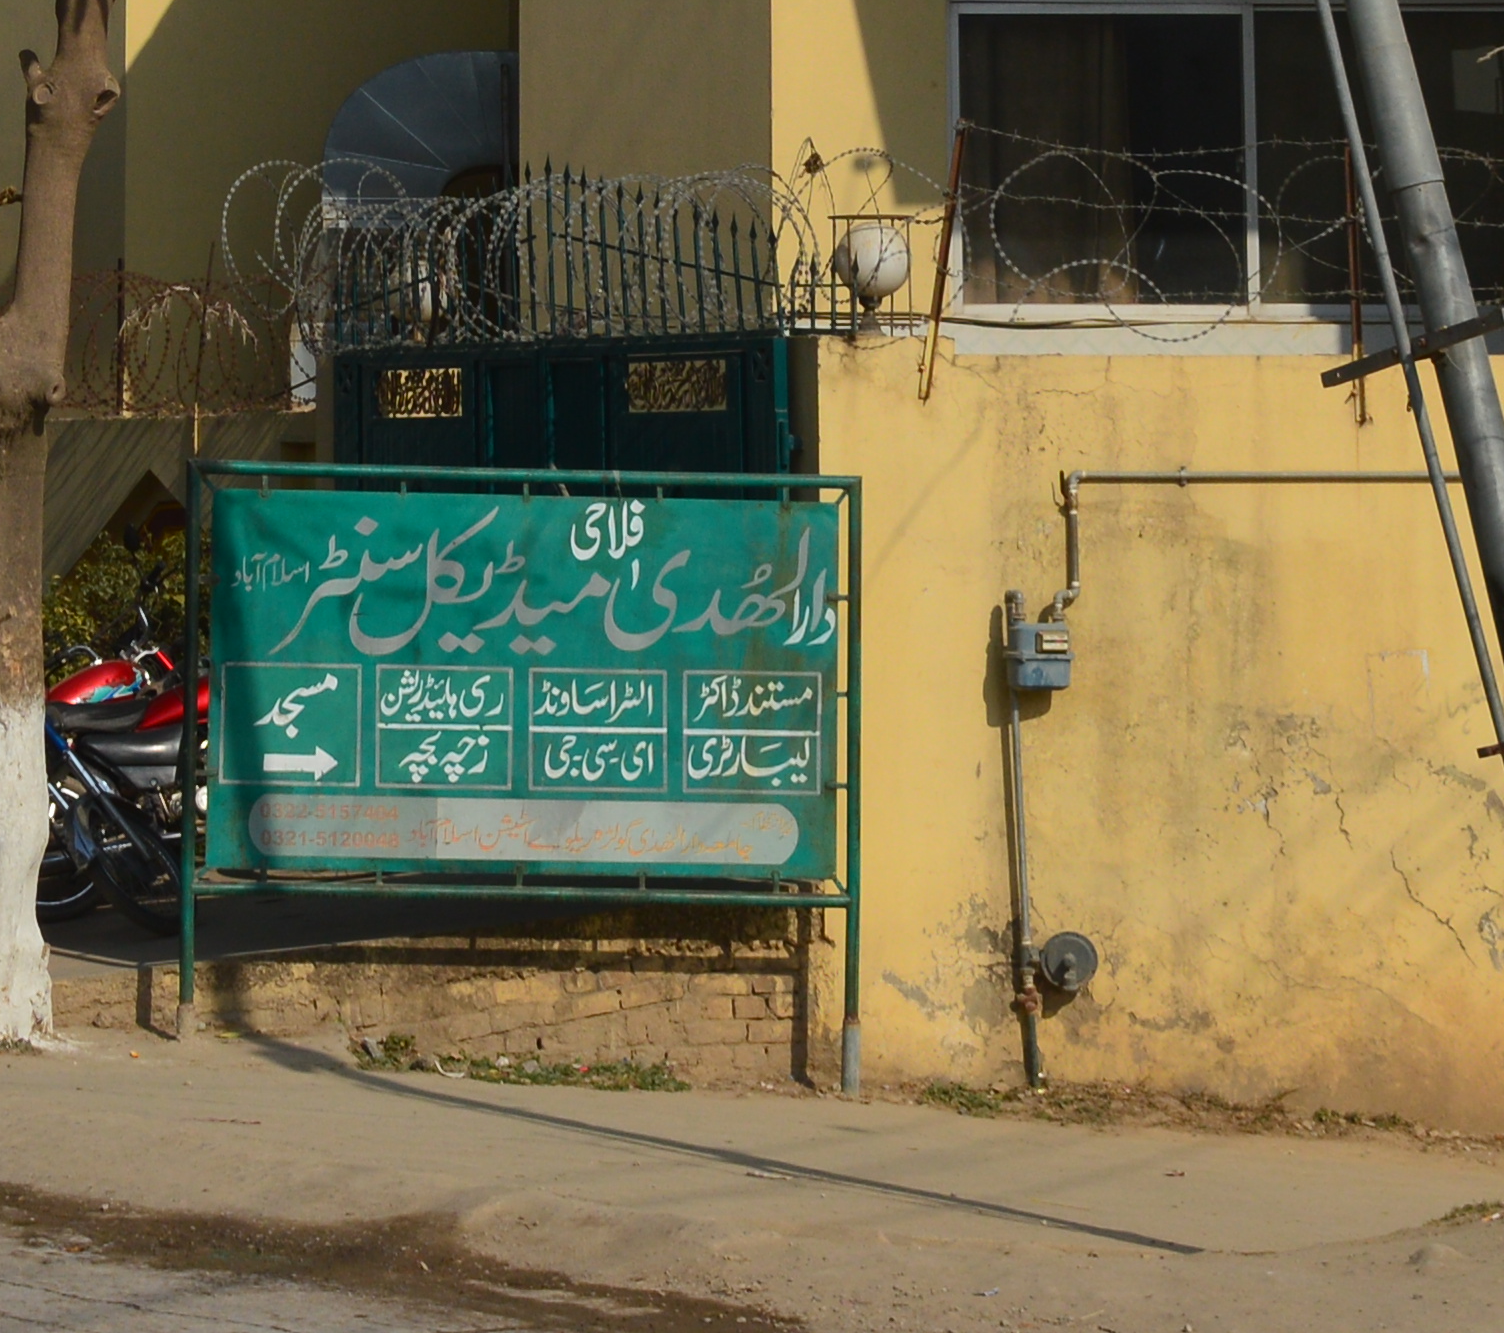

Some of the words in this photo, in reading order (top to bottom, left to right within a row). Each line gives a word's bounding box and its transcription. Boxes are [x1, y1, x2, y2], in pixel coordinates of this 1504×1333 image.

[570, 499, 646, 561] فلاحی
[348, 505, 612, 656] میڈیکل
[253, 672, 339, 739] مسجد
[692, 674, 743, 722] ڈاکٹر
[734, 680, 813, 717] مستند
[398, 730, 442, 783] بچہ
[439, 735, 490, 783] زچہ
